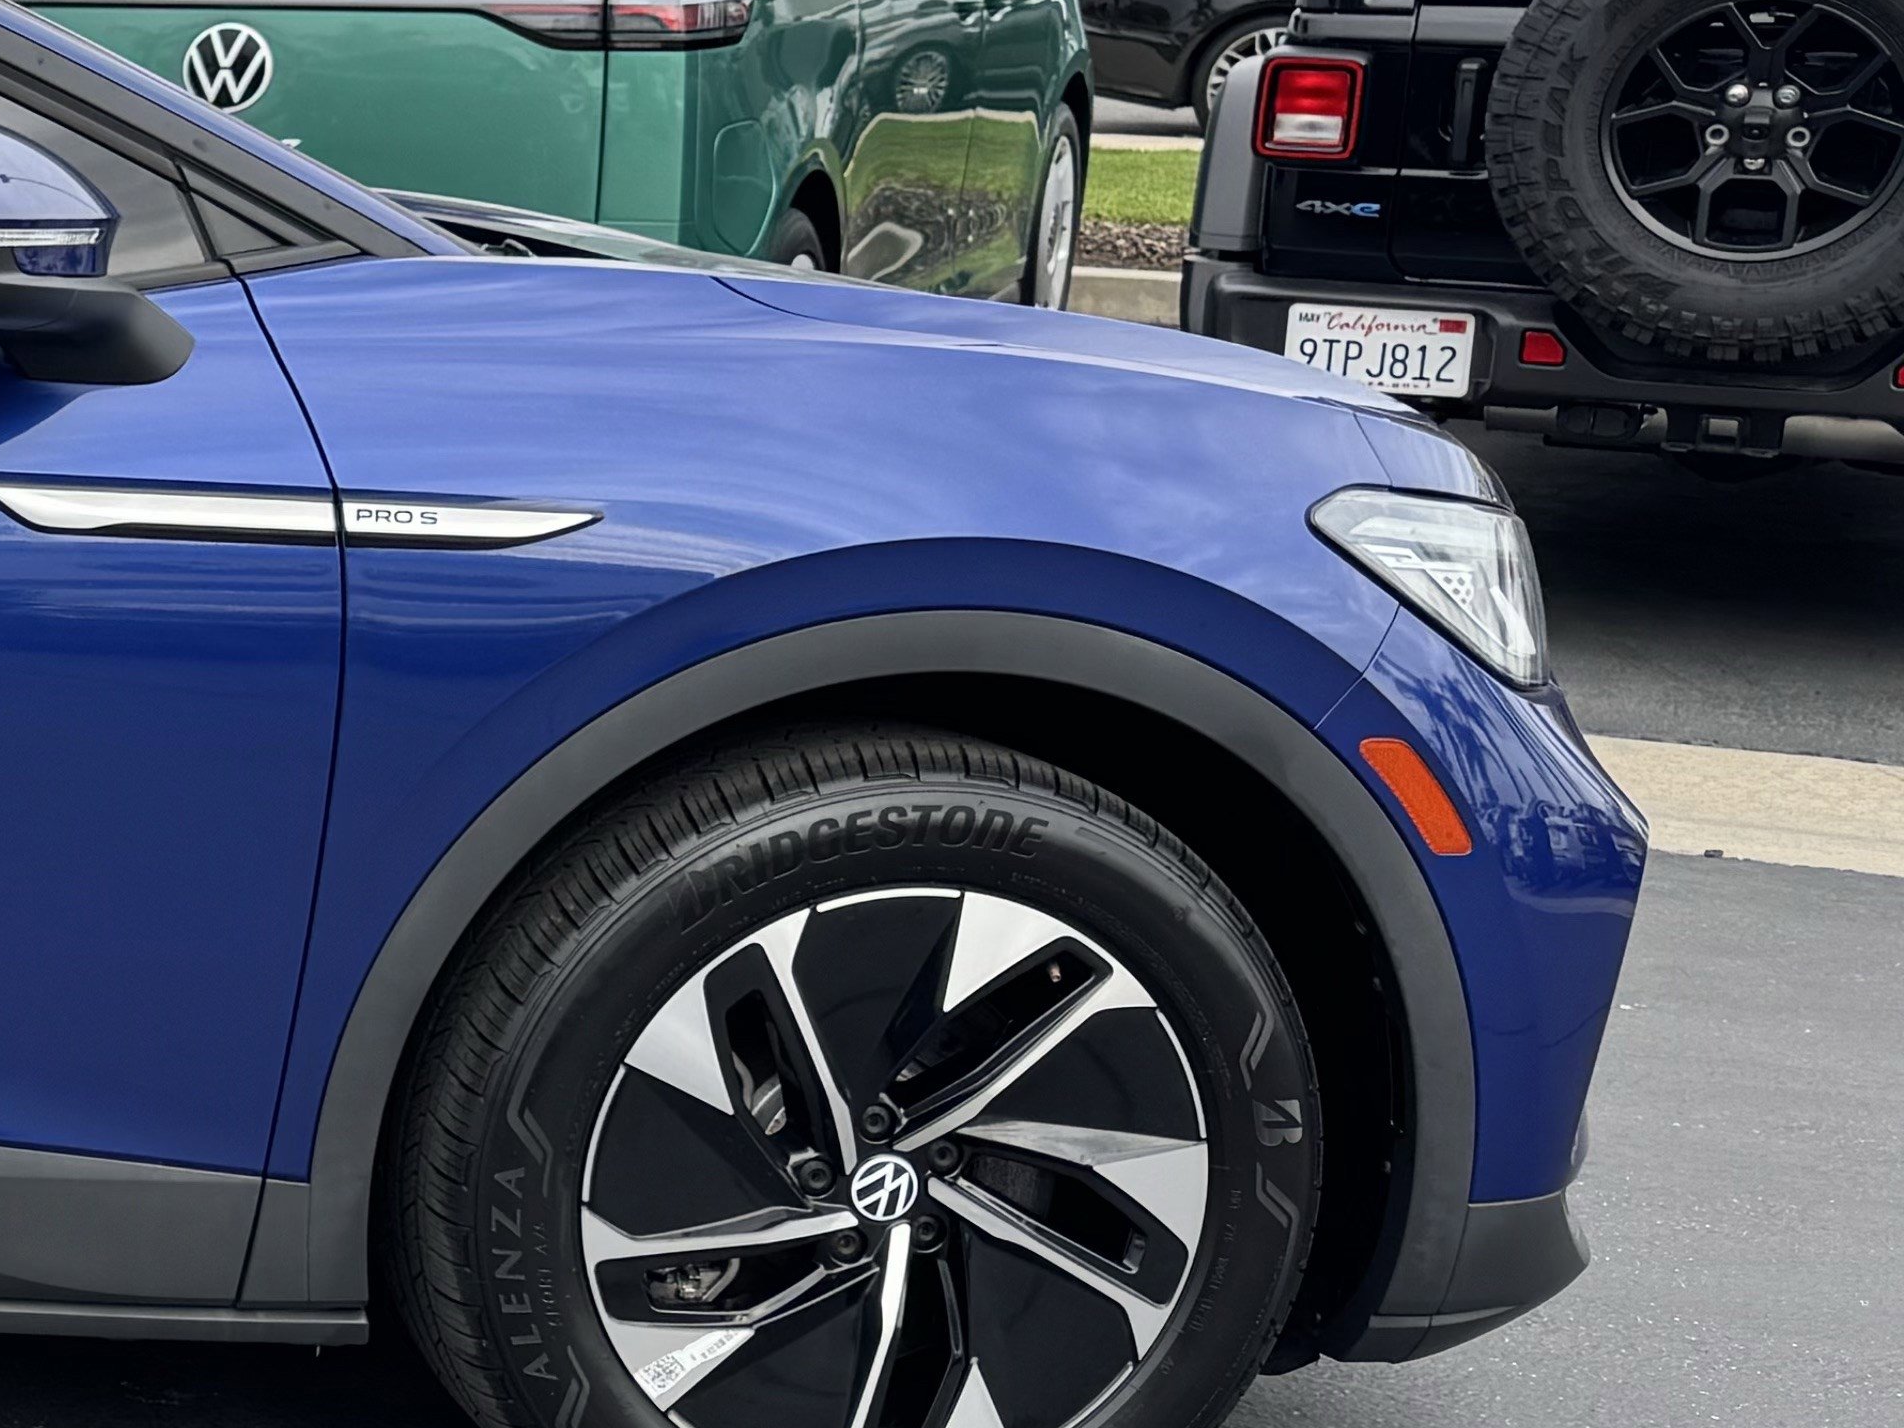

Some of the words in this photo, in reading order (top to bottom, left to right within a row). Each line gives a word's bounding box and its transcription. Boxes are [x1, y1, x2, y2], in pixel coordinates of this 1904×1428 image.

[1327, 312, 1438, 337] California
[1299, 338, 1457, 383] 9TPJ812
[356, 508, 413, 523] PRO
[420, 512, 438, 525] S
[663, 804, 1050, 934] BRIDGESTONE
[491, 1166, 560, 1381] ALENZA
